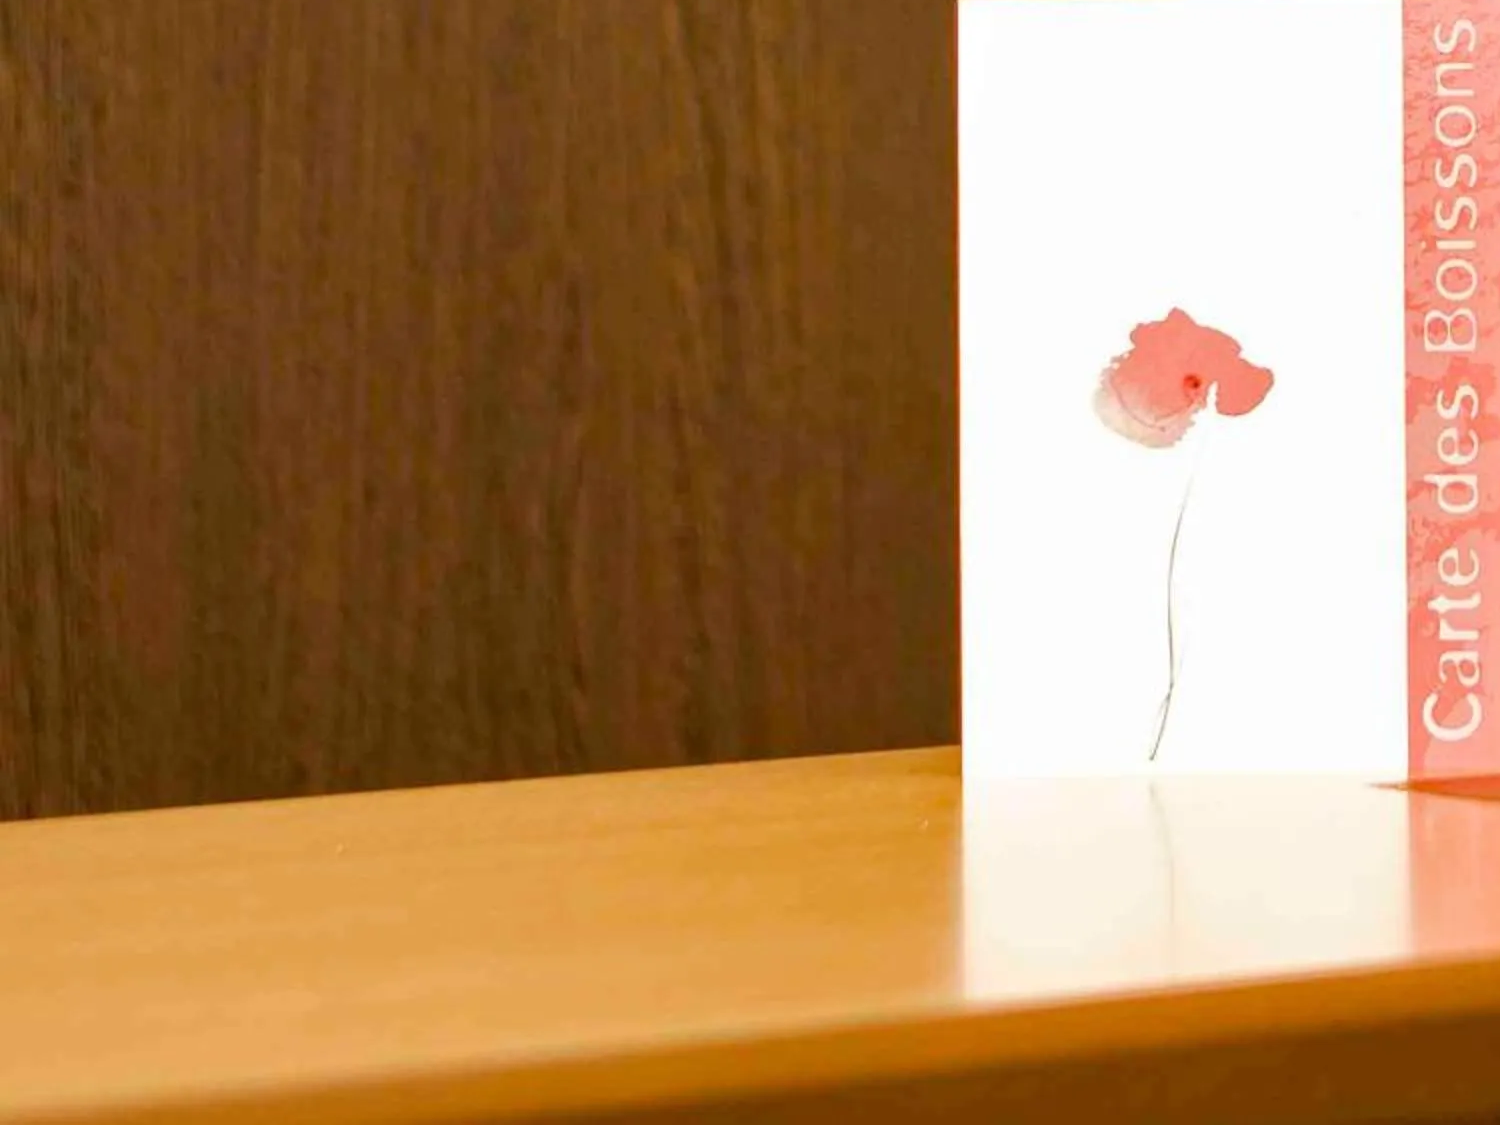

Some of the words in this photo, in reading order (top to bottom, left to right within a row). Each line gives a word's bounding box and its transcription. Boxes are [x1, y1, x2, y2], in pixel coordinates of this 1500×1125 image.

[1421, 19, 1479, 354] Boissons
[1422, 385, 1480, 513] des
[1422, 548, 1481, 742] Carte
